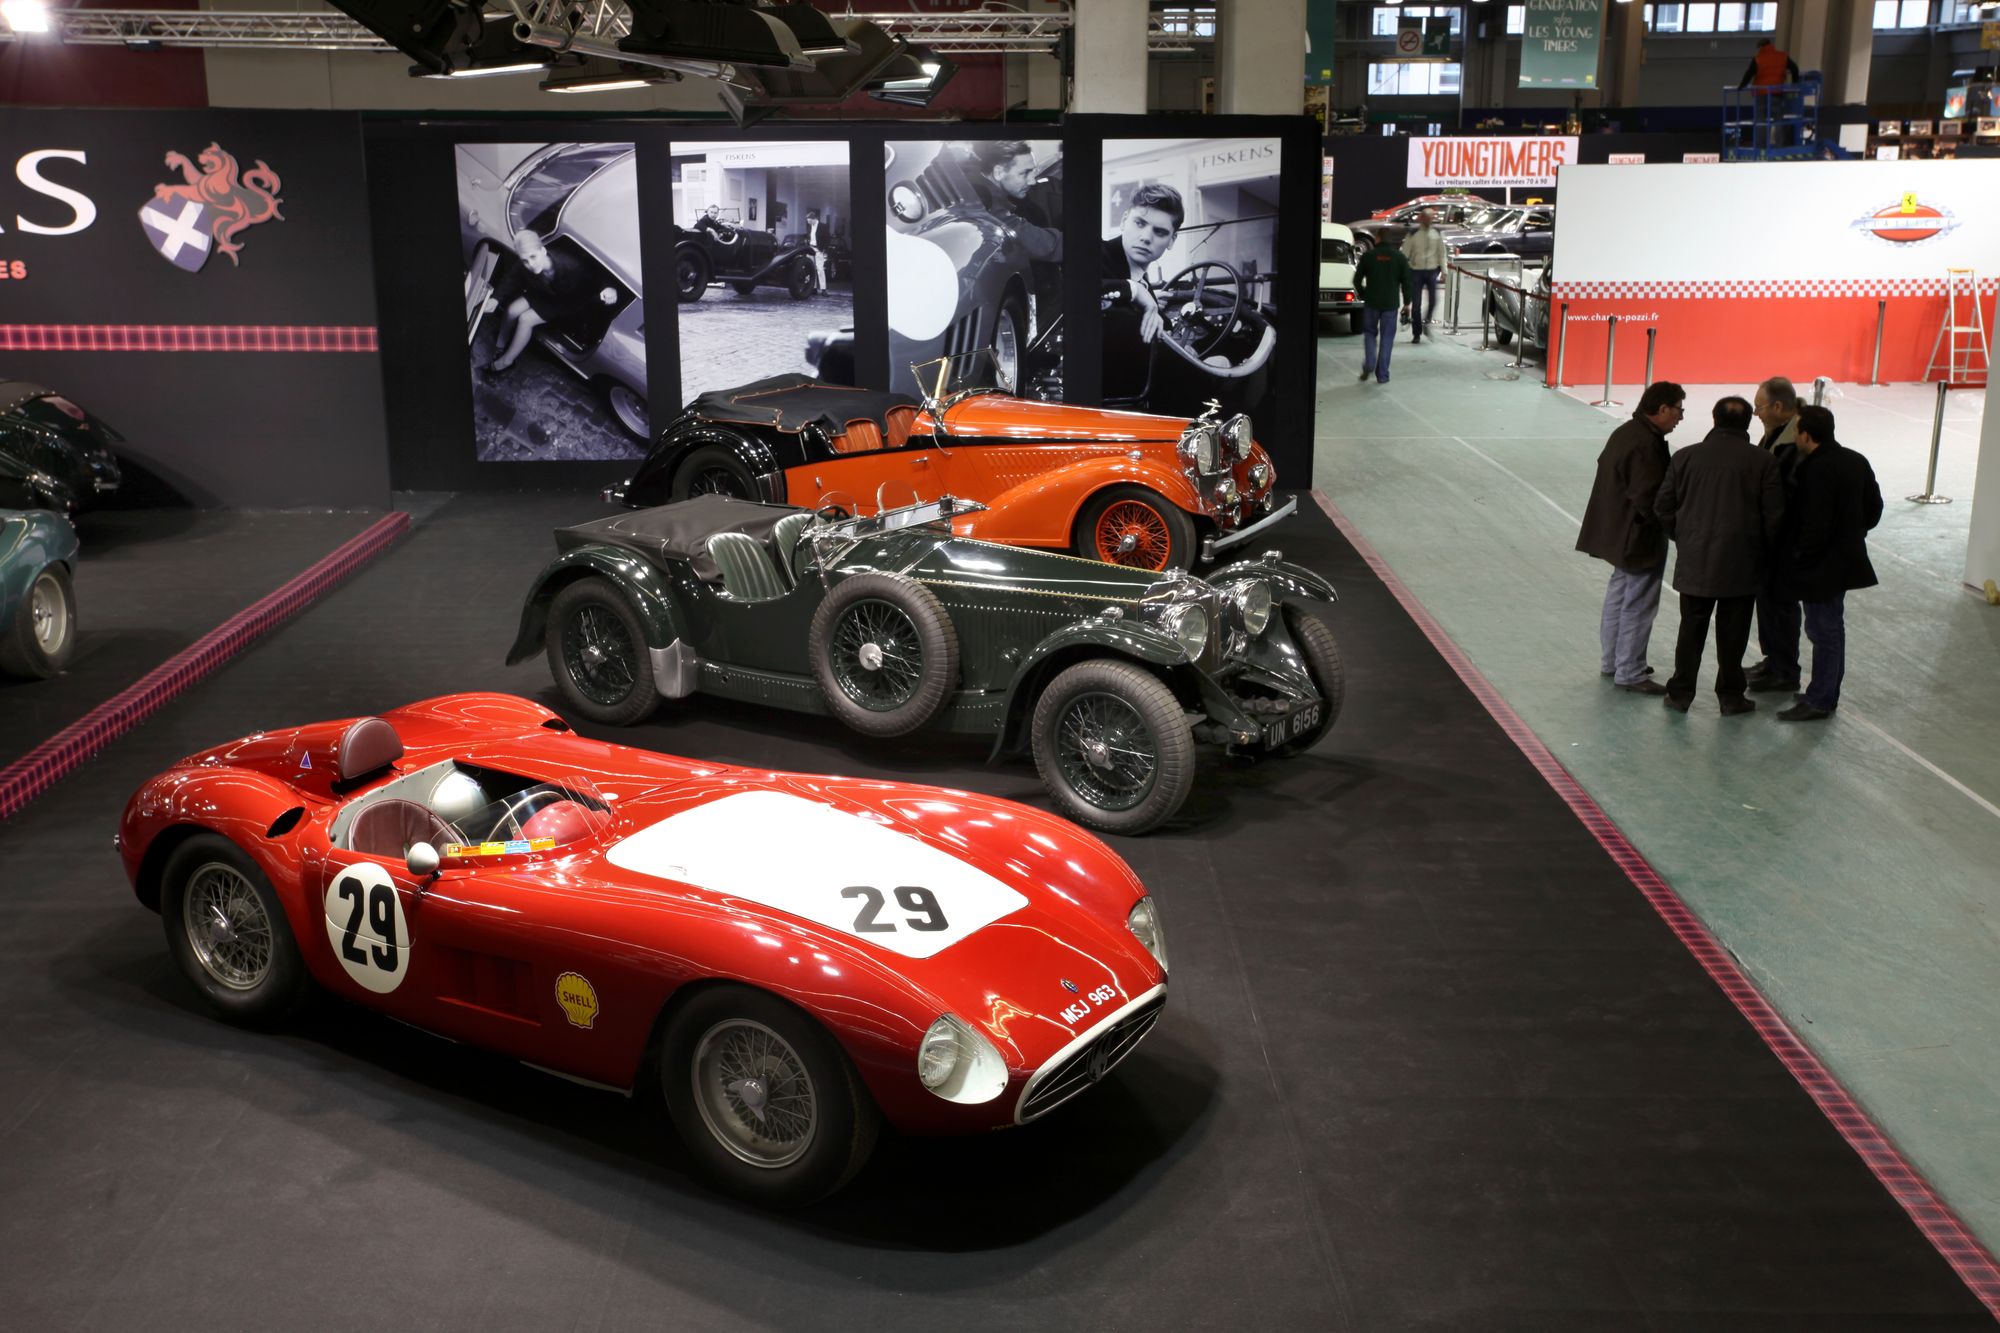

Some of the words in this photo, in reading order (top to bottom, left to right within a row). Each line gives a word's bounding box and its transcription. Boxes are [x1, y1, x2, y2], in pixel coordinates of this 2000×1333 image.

[1528, 25, 1549, 38] LES
[1555, 26, 1593, 39] YOUNG
[1543, 40, 1578, 52] TIMERS
[1202, 144, 1274, 168] FISKENS
[1422, 141, 1565, 177] YOUNGTIMERS
[1270, 720, 1286, 746] UN
[1293, 705, 1319, 734] 6156
[339, 876, 398, 973] 29
[840, 886, 949, 932] 29
[563, 991, 592, 1009] SHELL
[1060, 999, 1091, 1025] MSJ
[1088, 984, 1116, 1006] 963
